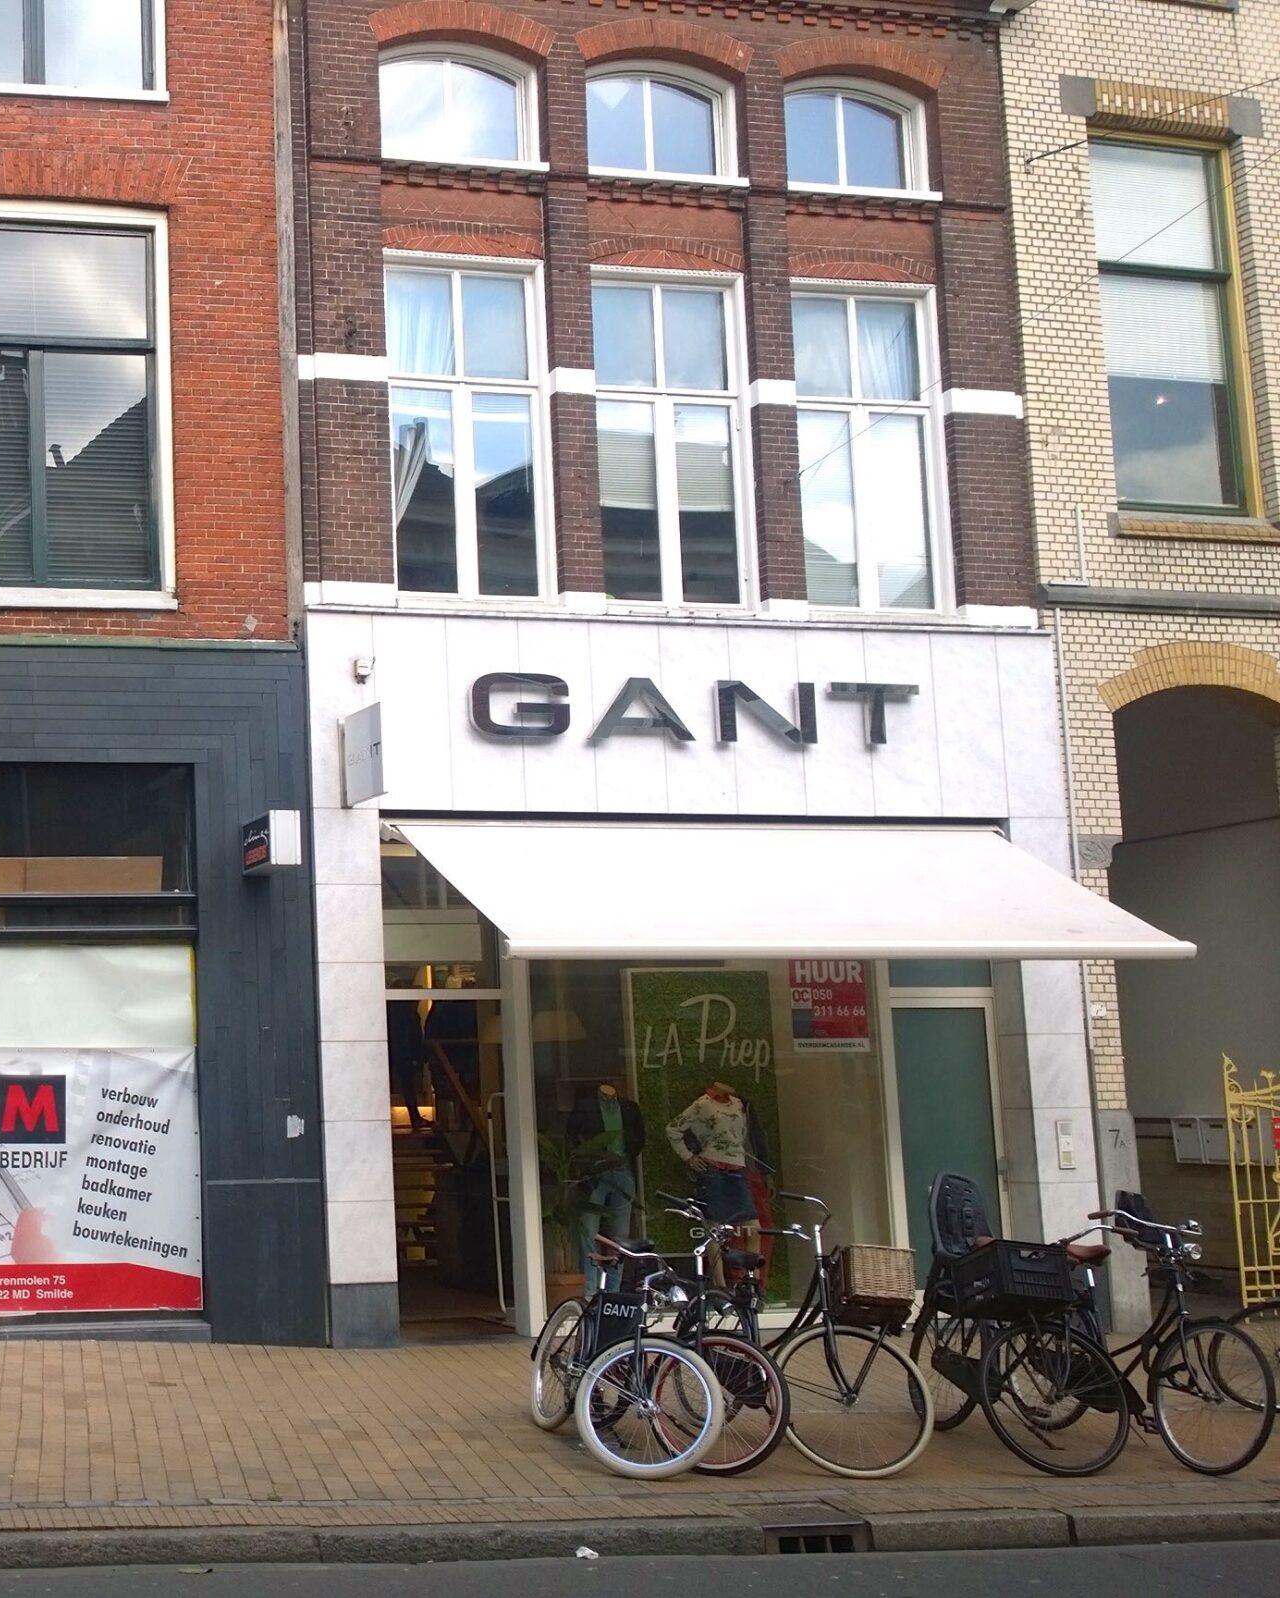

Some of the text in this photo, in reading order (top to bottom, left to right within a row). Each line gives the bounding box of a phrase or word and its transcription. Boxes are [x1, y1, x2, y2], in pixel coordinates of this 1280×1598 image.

[469, 672, 920, 746] GANT
[794, 960, 864, 984] HUUR
[812, 989, 833, 1000] 050
[814, 1005, 866, 1016] 311 66 66
[643, 993, 770, 1084] LA Prep
[101, 1086, 159, 1109] verbouw
[96, 1109, 171, 1135] onderhoud
[90, 1132, 157, 1156] renovatie
[85, 1154, 148, 1180] montage
[81, 1173, 153, 1203] badkamer
[76, 1196, 128, 1222] keuken
[72, 1220, 188, 1258] bouwtekeningen
[53, 1275, 66, 1285] 75
[12, 1289, 31, 1300] MD
[36, 1288, 74, 1299] Smilde
[602, 1302, 638, 1319] GANT
